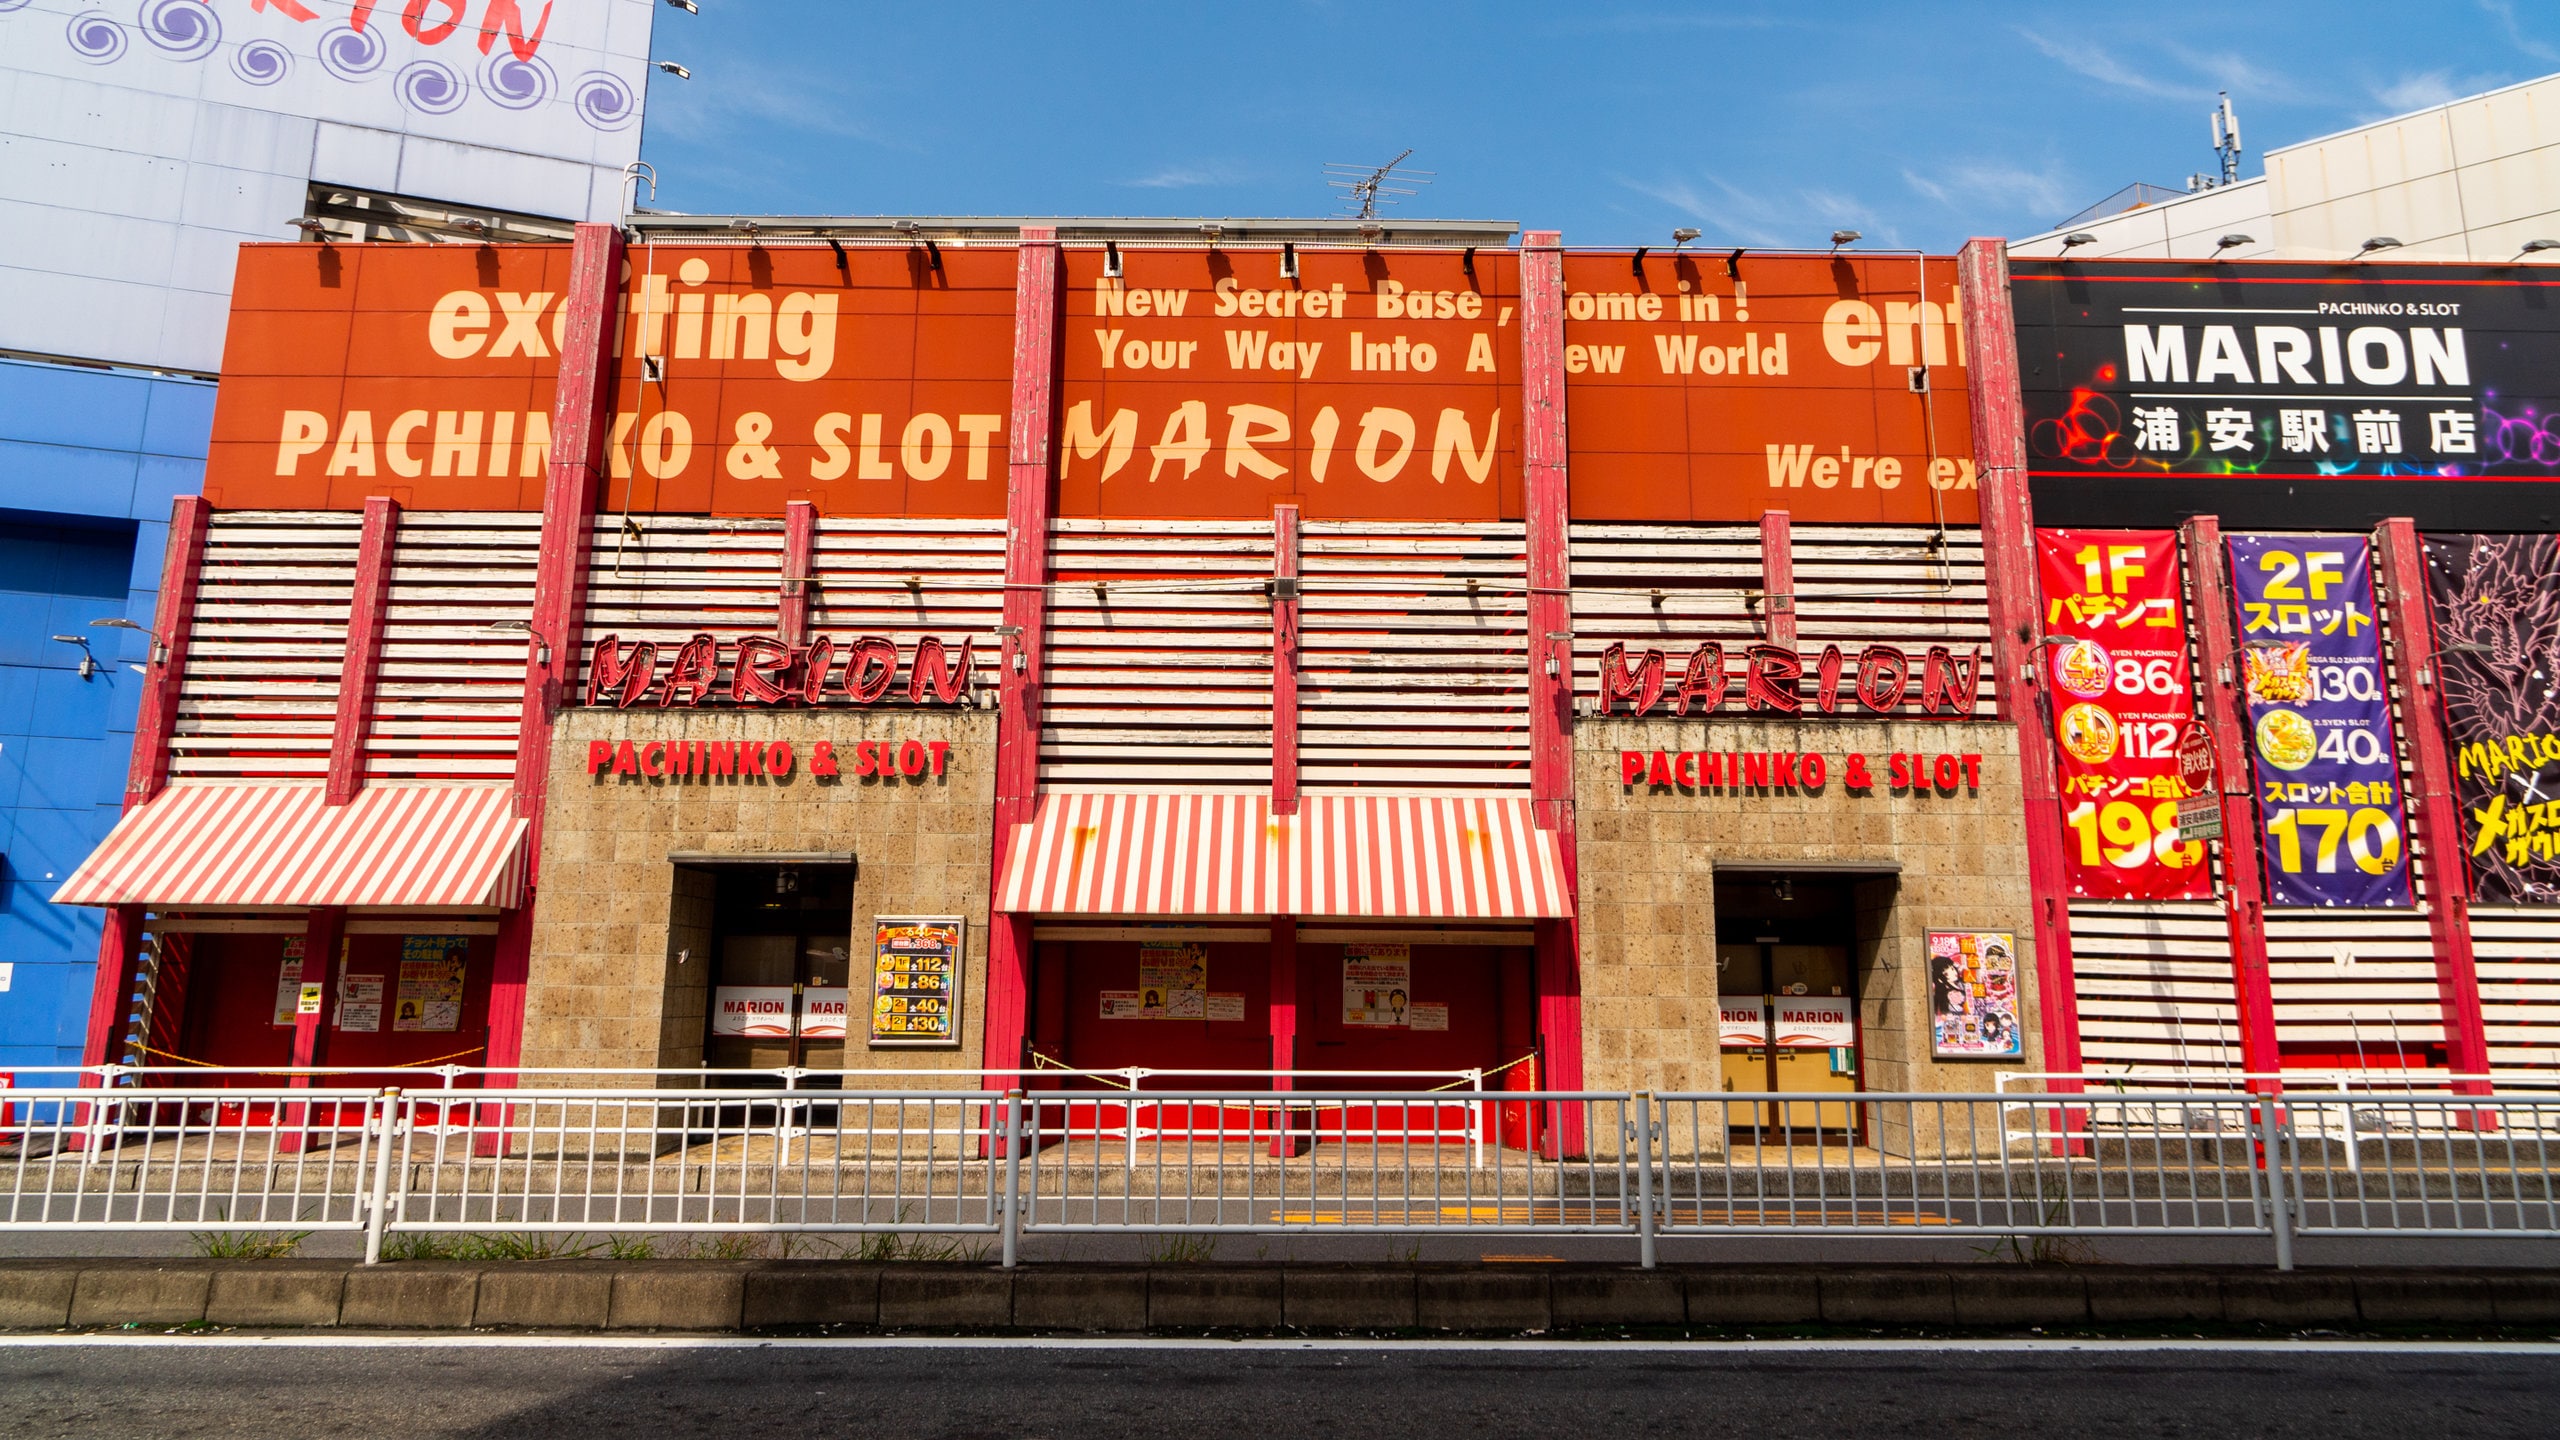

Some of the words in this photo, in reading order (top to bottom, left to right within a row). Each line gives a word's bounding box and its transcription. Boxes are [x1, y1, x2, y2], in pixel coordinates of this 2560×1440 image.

[1095, 277, 1188, 317] New
[1214, 278, 1346, 319] Secret
[1563, 283, 1663, 321] ome
[2319, 301, 2403, 316] PACHINKO
[2406, 303, 2419, 316] &
[2420, 303, 2460, 316] SLOT
[1094, 329, 1197, 369] Your
[1224, 330, 1322, 379] Way
[1351, 332, 1437, 372] Into
[1465, 333, 1496, 373] A
[1654, 332, 1789, 375] World
[2123, 324, 2472, 386] MARION
[726, 412, 783, 480] &
[810, 412, 1001, 481] SLOT
[1061, 400, 1500, 484] MARION
[2132, 406, 2478, 455] 浦安駅前店
[1765, 444, 1901, 489] We're
[2075, 545, 2146, 594] 1F
[2261, 550, 2345, 601] 2F
[2047, 594, 2176, 629] パチンコ
[2244, 602, 2371, 637] スロット
[587, 633, 972, 708] MARION
[2134, 650, 2178, 658] PACHINKO
[1601, 641, 1982, 716] MARION
[588, 740, 793, 776] PACHINKO
[810, 741, 839, 776] &
[854, 741, 950, 776] SLOT
[1621, 751, 1826, 788] PACHINKO
[1845, 753, 1874, 789] &
[1890, 754, 1982, 789] SLOT
[2182, 748, 2209, 775] 消火栓
[2265, 781, 2392, 805] スロット合計
[2505, 830, 2560, 867] ザウ
[723, 1001, 784, 1013] MARION
[811, 1002, 847, 1014] MAR
[1783, 1011, 1843, 1023] MARION
